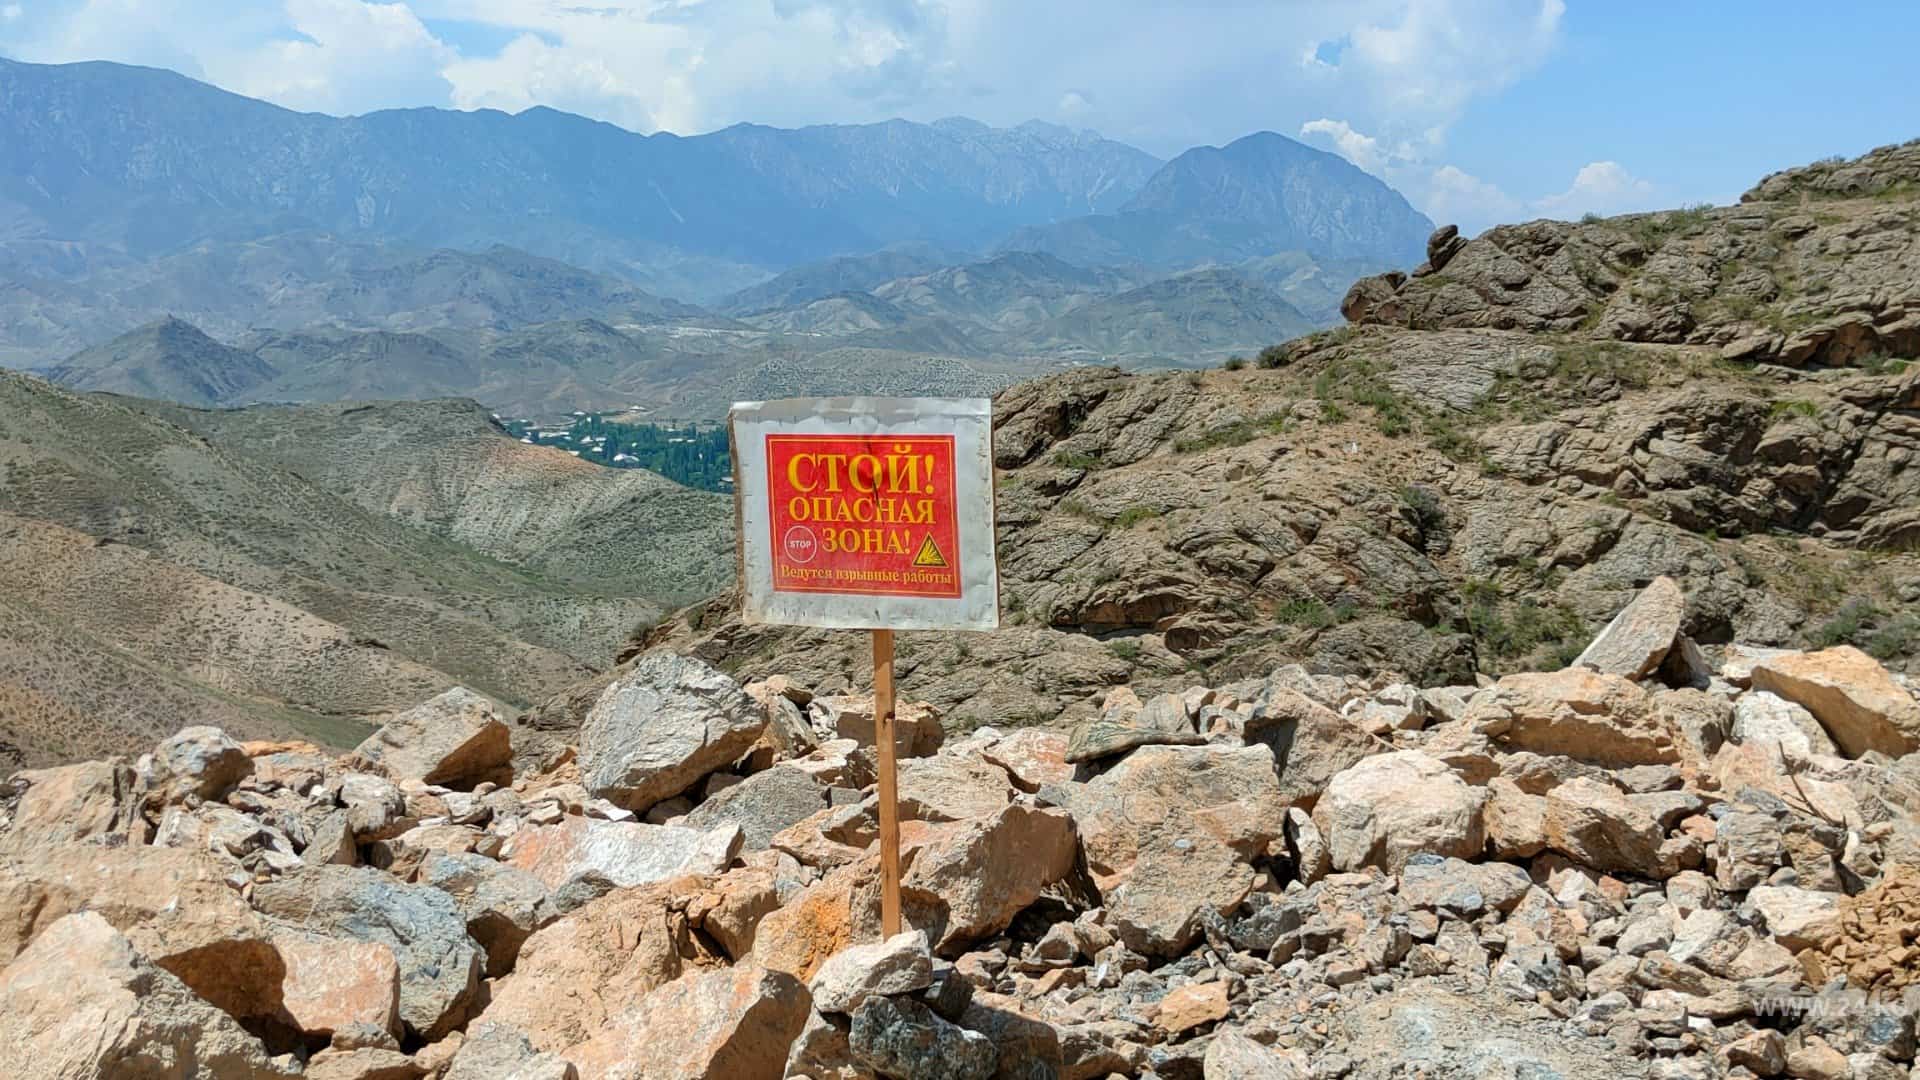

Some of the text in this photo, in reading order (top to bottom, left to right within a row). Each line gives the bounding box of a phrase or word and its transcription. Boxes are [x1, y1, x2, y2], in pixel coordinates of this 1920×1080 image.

[787, 444, 935, 495] СТОЙ!
[788, 496, 936, 524] ОПАСНАЯ
[789, 540, 812, 549] STOP
[822, 527, 911, 555] ЗОНА!
[781, 564, 952, 585] Ведутся взрывные работы
